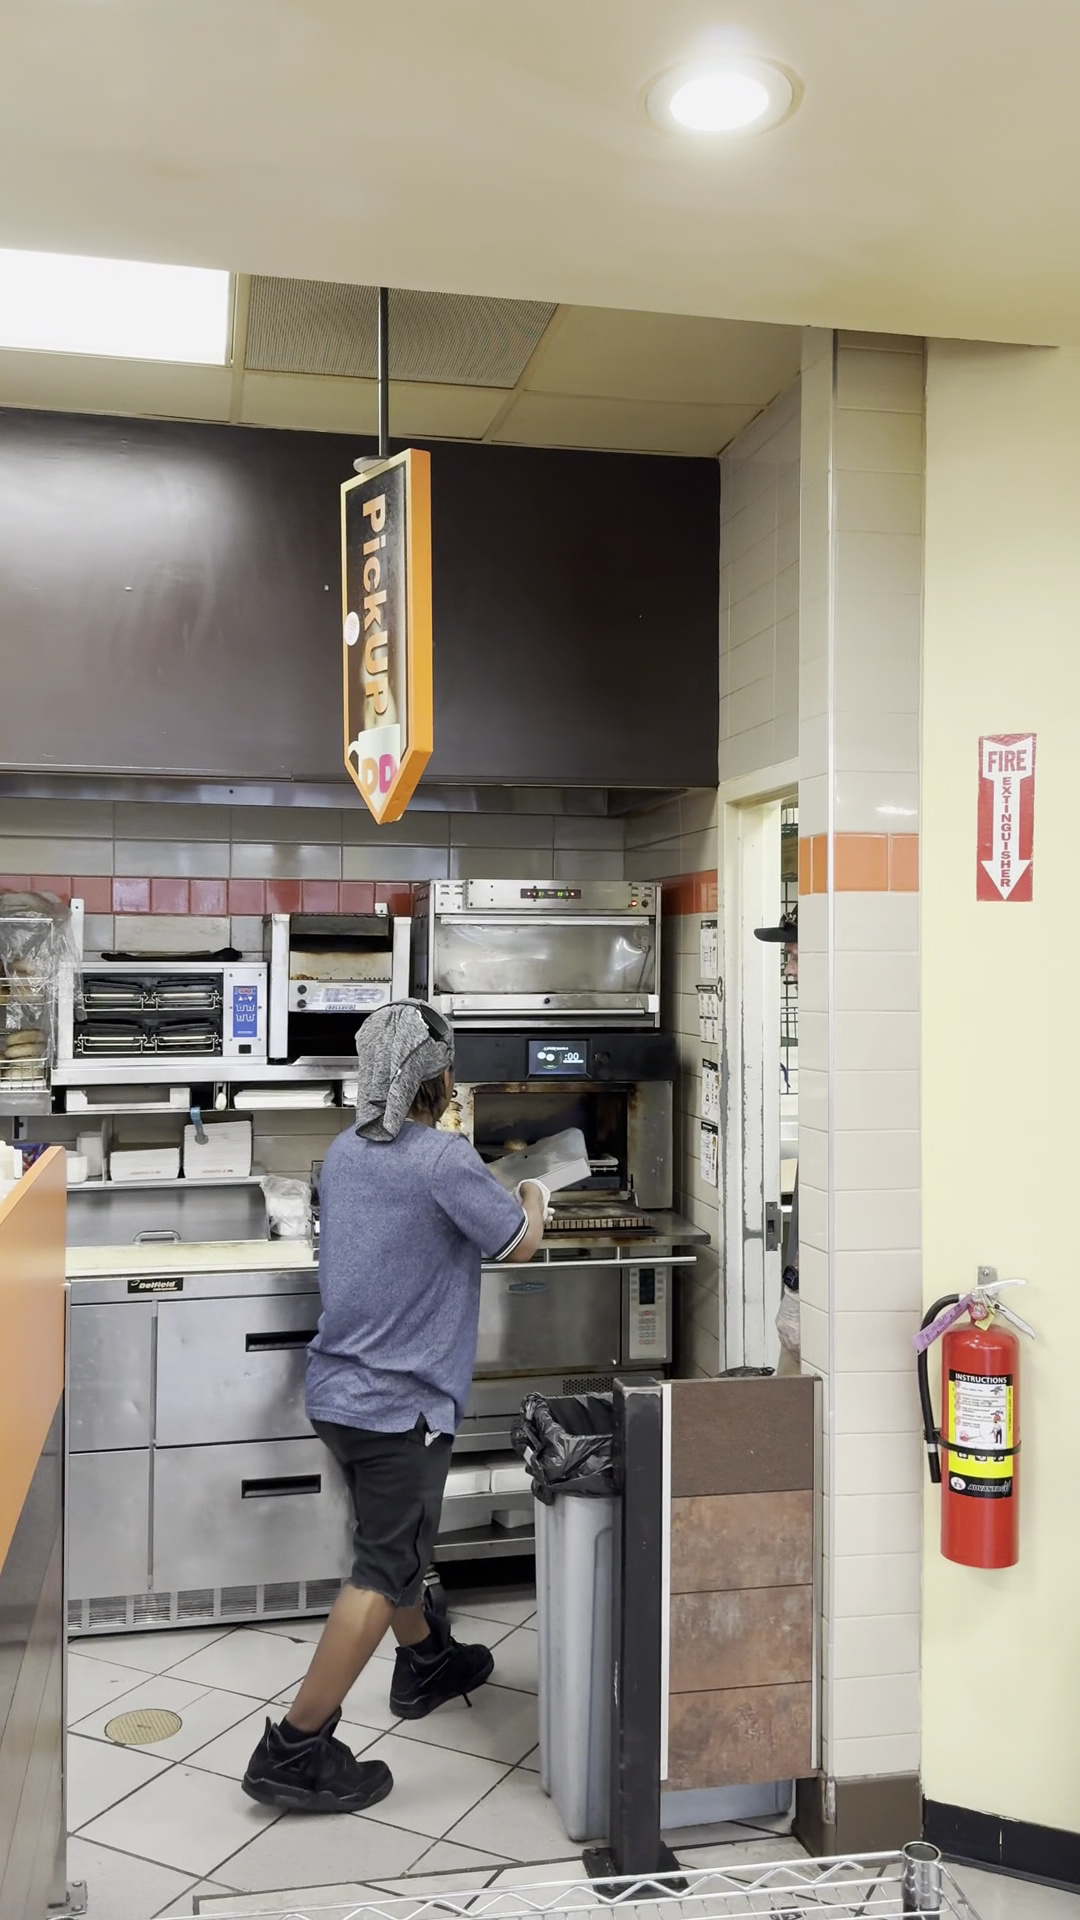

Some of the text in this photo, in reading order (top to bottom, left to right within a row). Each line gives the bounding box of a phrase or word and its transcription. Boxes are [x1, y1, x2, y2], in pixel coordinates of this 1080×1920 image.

[987, 749, 1027, 773] FIRE
[1000, 776, 1013, 888] EXTINGUISHER
[138, 1280, 177, 1290] Delfield
[955, 1371, 1007, 1384] INSTRUCTIONS
